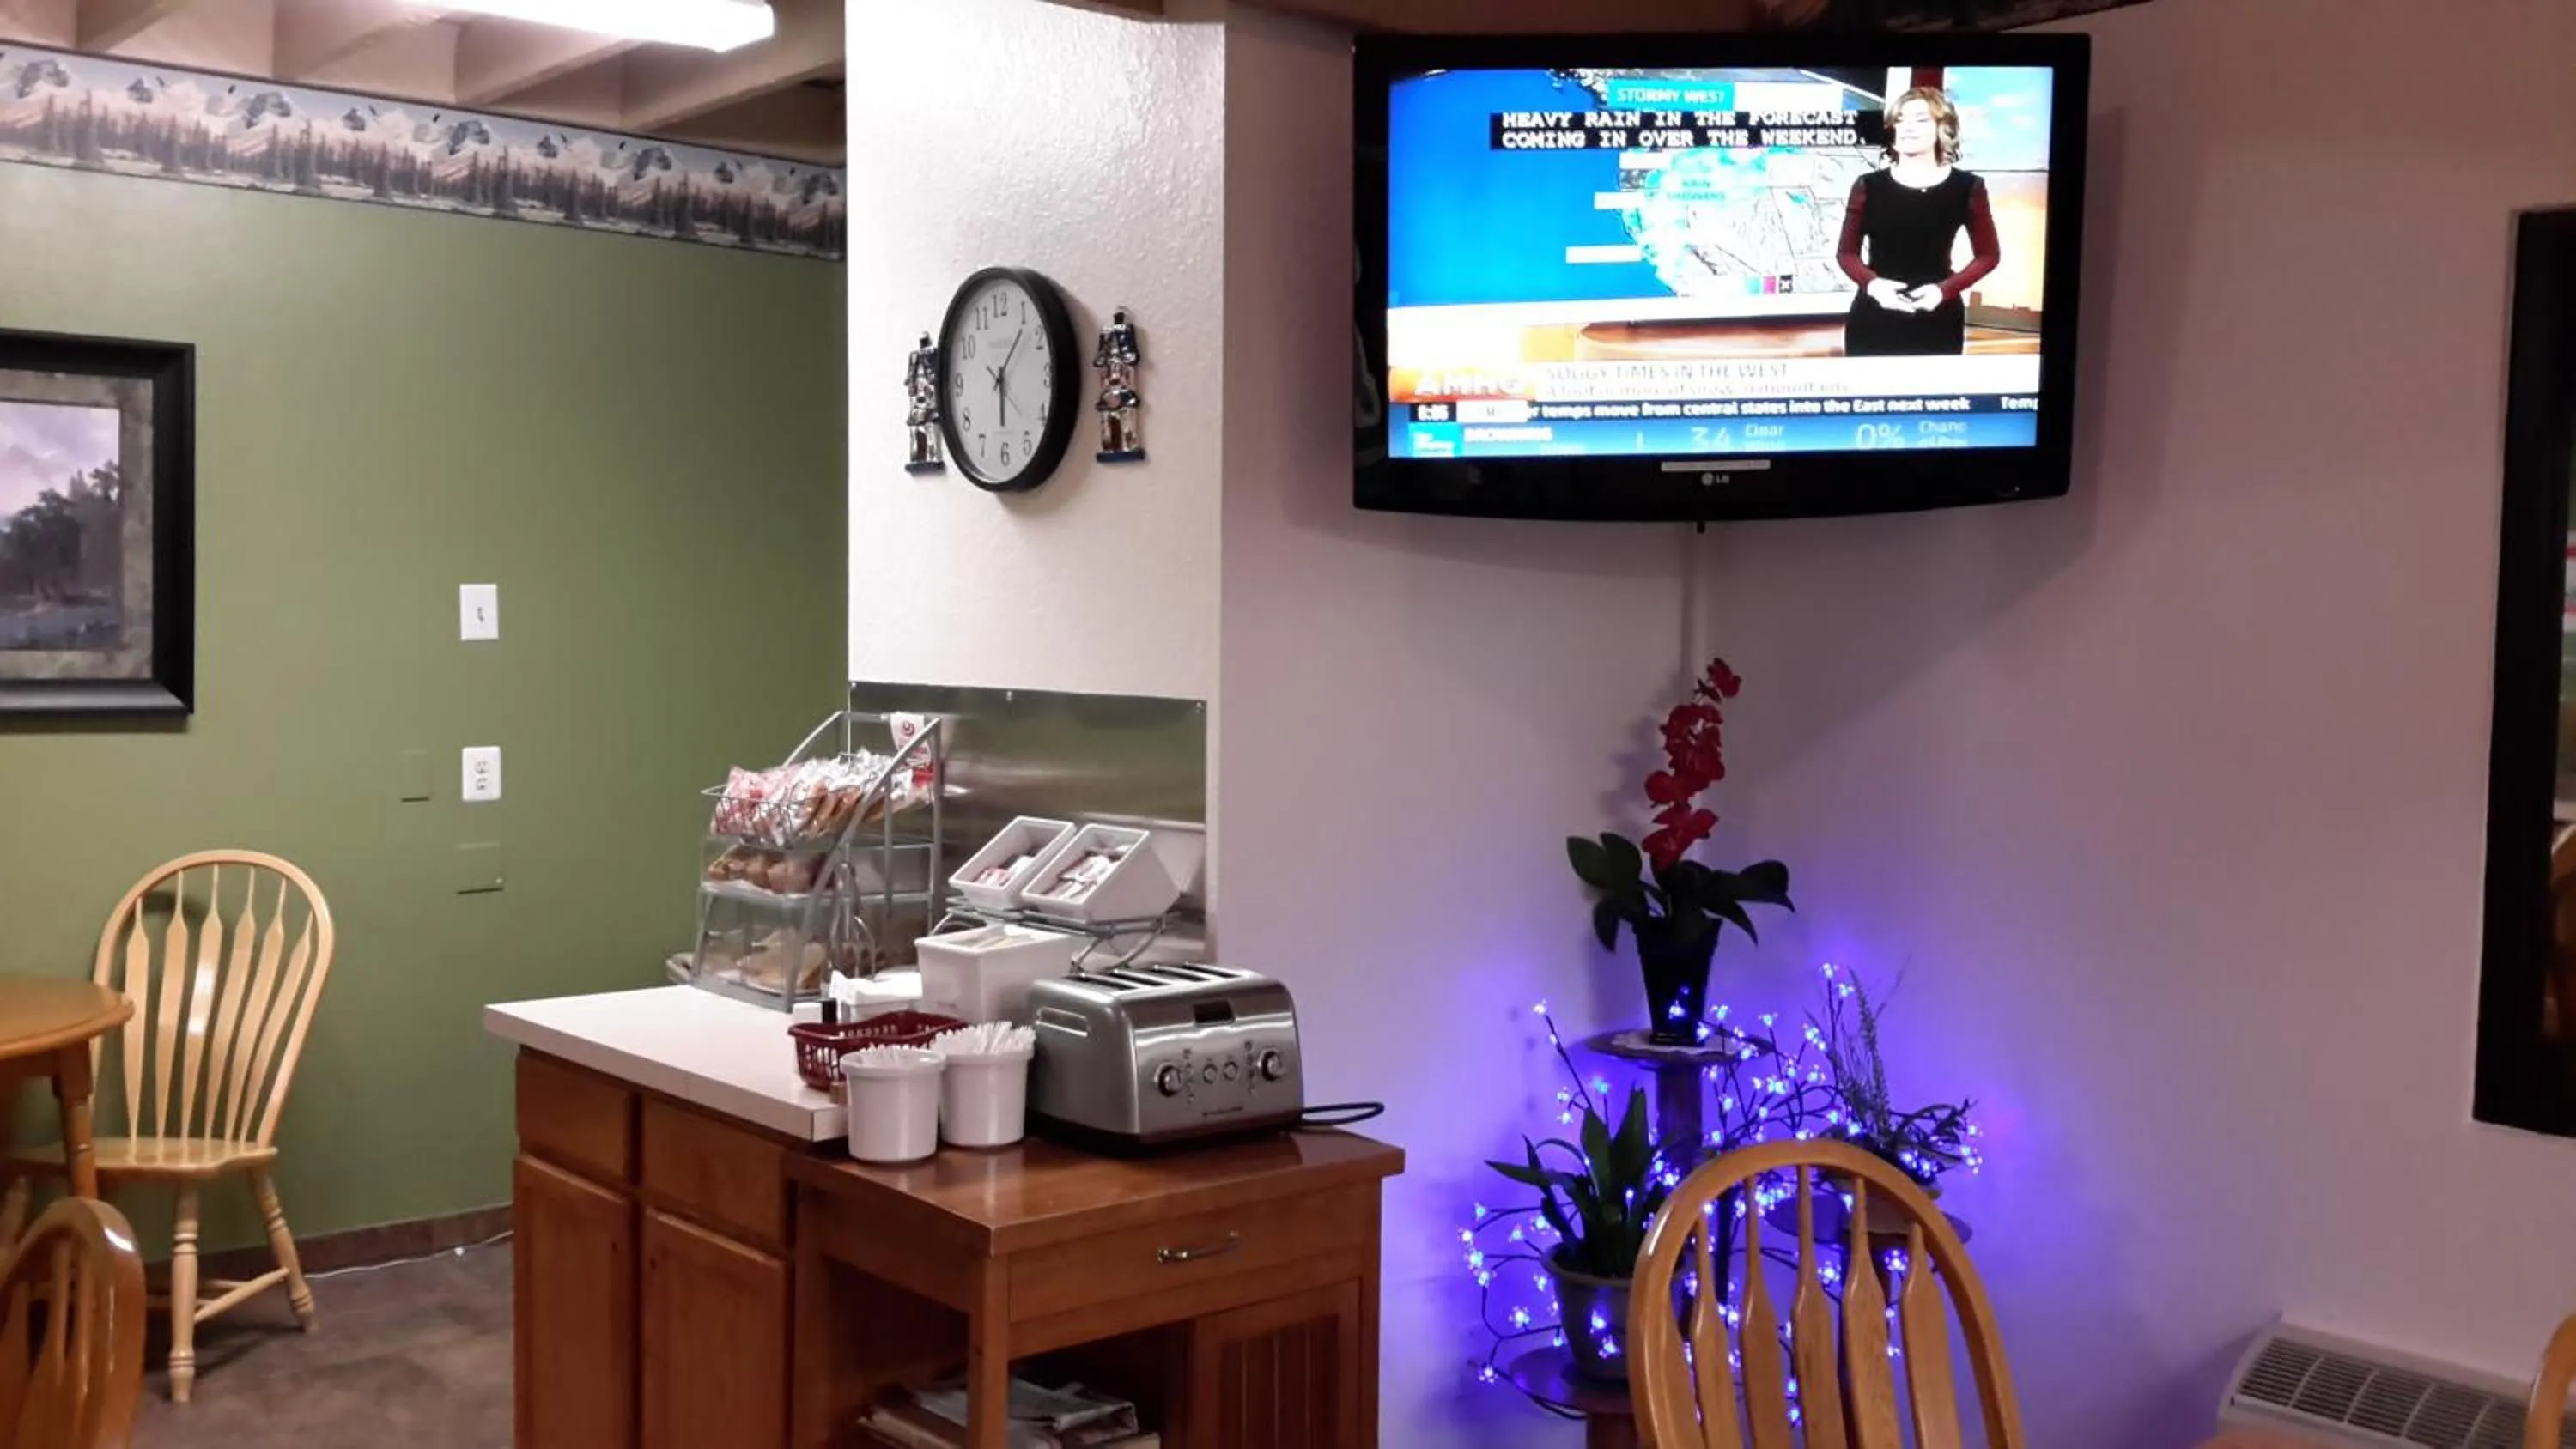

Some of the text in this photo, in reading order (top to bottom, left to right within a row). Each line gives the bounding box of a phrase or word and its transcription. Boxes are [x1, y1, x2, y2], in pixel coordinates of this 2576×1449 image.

[1616, 88, 1725, 104] STORMY WEST
[1503, 110, 1859, 128] HEAVY RAIN IN THE FORECAST
[1502, 129, 1867, 149] COMING IN OVER THE WEEKEND.
[993, 292, 1008, 318] 12
[1020, 301, 1027, 325] 1
[975, 306, 990, 330] 11
[961, 334, 976, 361] 10
[1035, 324, 1045, 351] 2
[954, 371, 963, 398] 9
[1043, 362, 1052, 389] 3
[1546, 363, 1787, 381] SOGGY TIMES IN THE WEST
[962, 407, 971, 431] 8
[1037, 402, 1048, 427] 4
[1541, 405, 1592, 421] temps
[1594, 404, 1640, 417] move
[1642, 402, 1681, 416] from
[1682, 401, 1738, 416] central
[1741, 401, 1787, 415] states
[1789, 399, 1821, 413] into
[1822, 398, 1850, 413] the
[1853, 398, 1885, 413] East
[1887, 397, 1924, 411] next
[1924, 397, 1971, 411] week
[978, 433, 987, 458] 7
[1022, 430, 1032, 457] 5
[1856, 422, 1906, 450] 0%
[999, 442, 1011, 467] 6
[1716, 473, 1730, 484] LG
